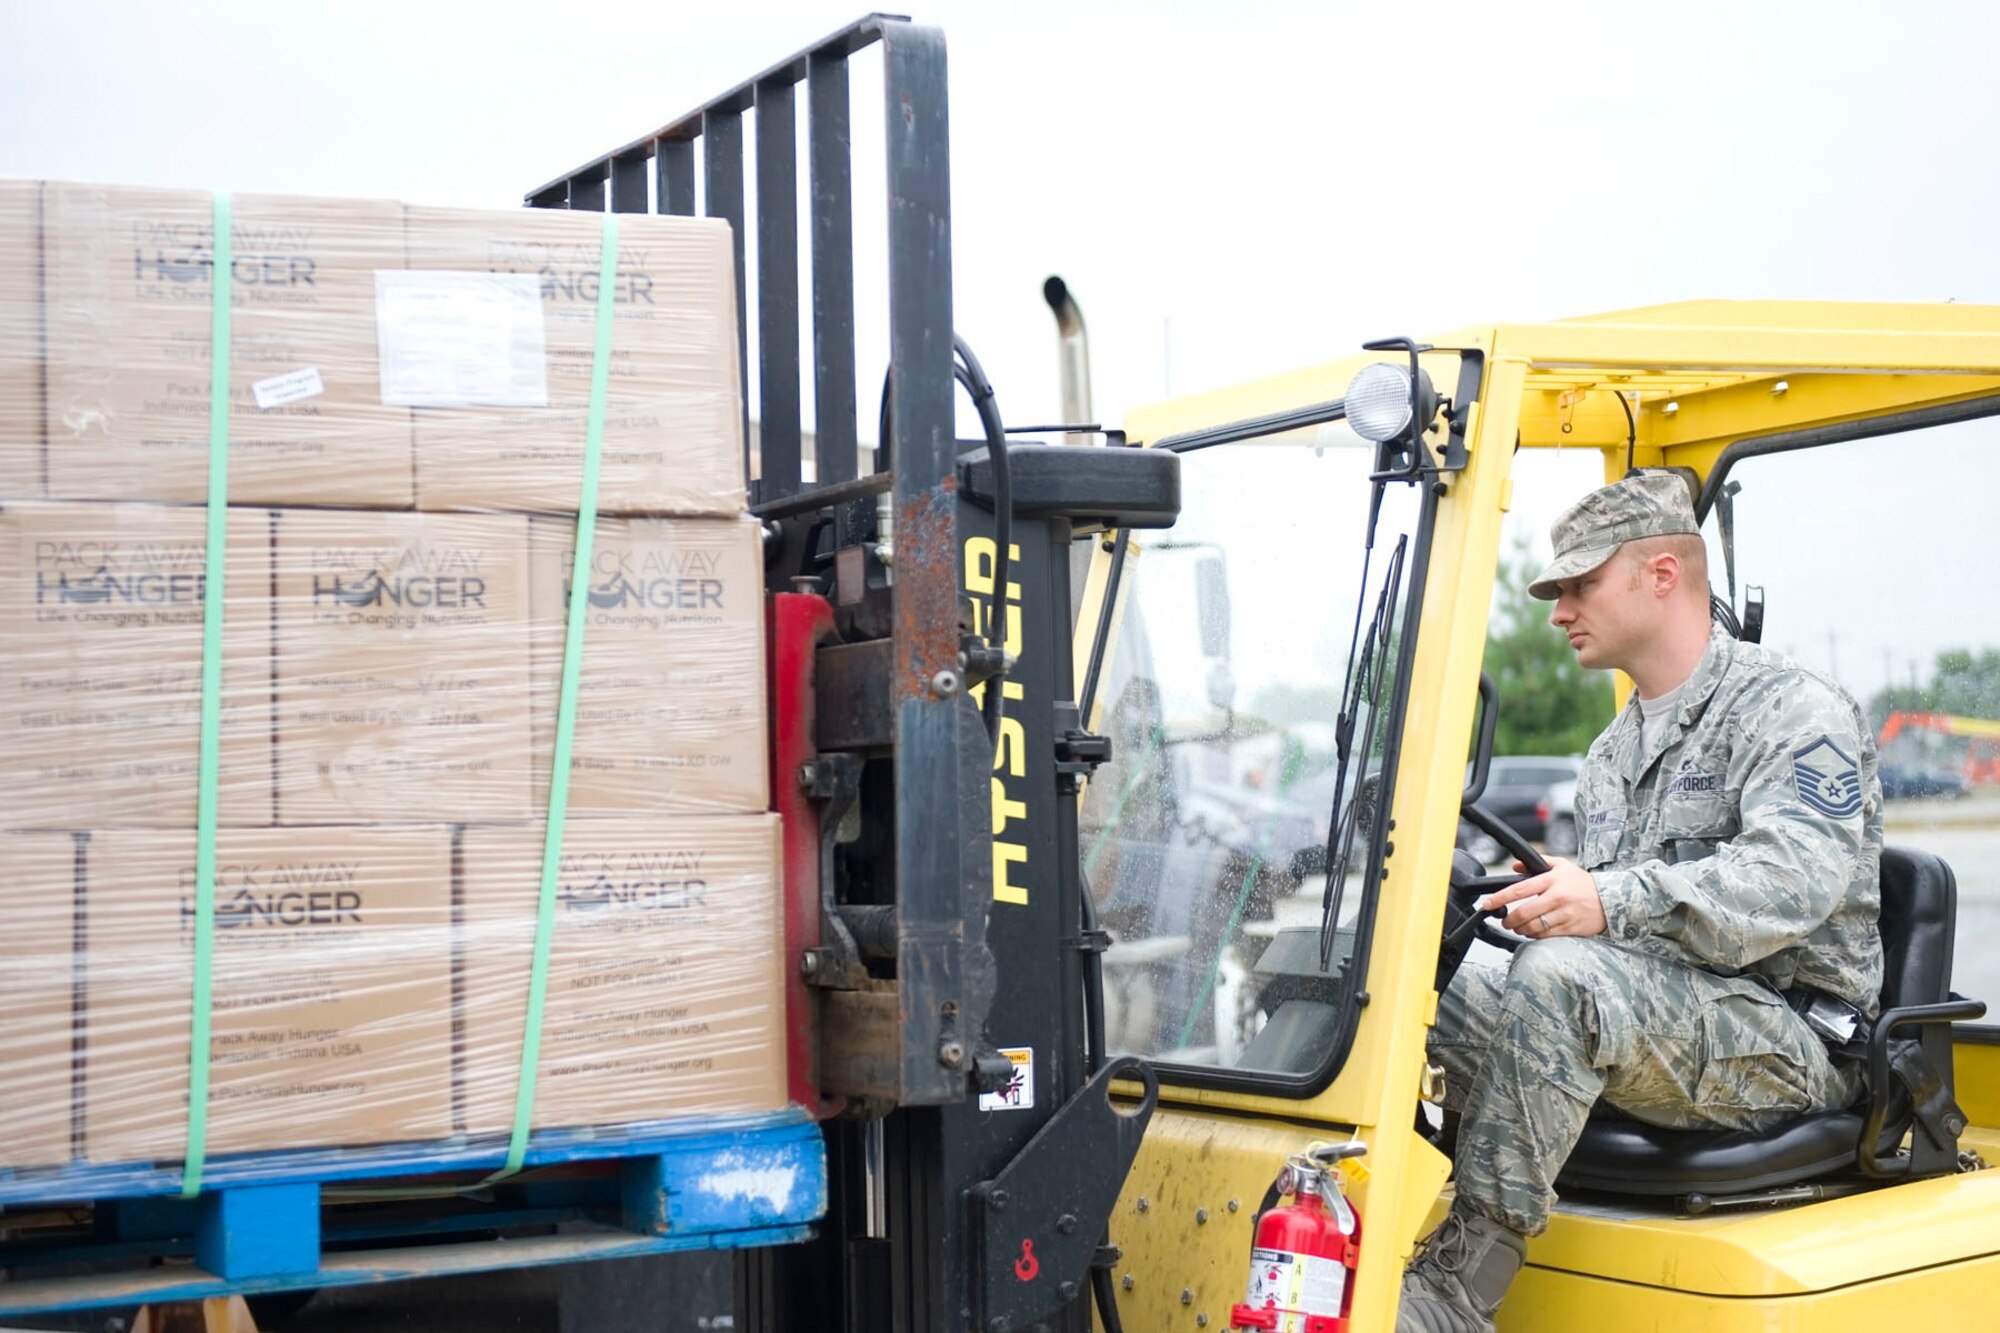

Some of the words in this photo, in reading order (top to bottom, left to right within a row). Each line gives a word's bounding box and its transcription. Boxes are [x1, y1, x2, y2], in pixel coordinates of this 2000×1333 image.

[35, 542, 120, 566] PACK
[641, 551, 722, 575] AWAY
[594, 614, 660, 629] Changing
[1677, 775, 1717, 791] FORCE
[625, 850, 706, 871] AWAY
[270, 861, 360, 888] AWAY
[681, 1022, 710, 1034] USA
